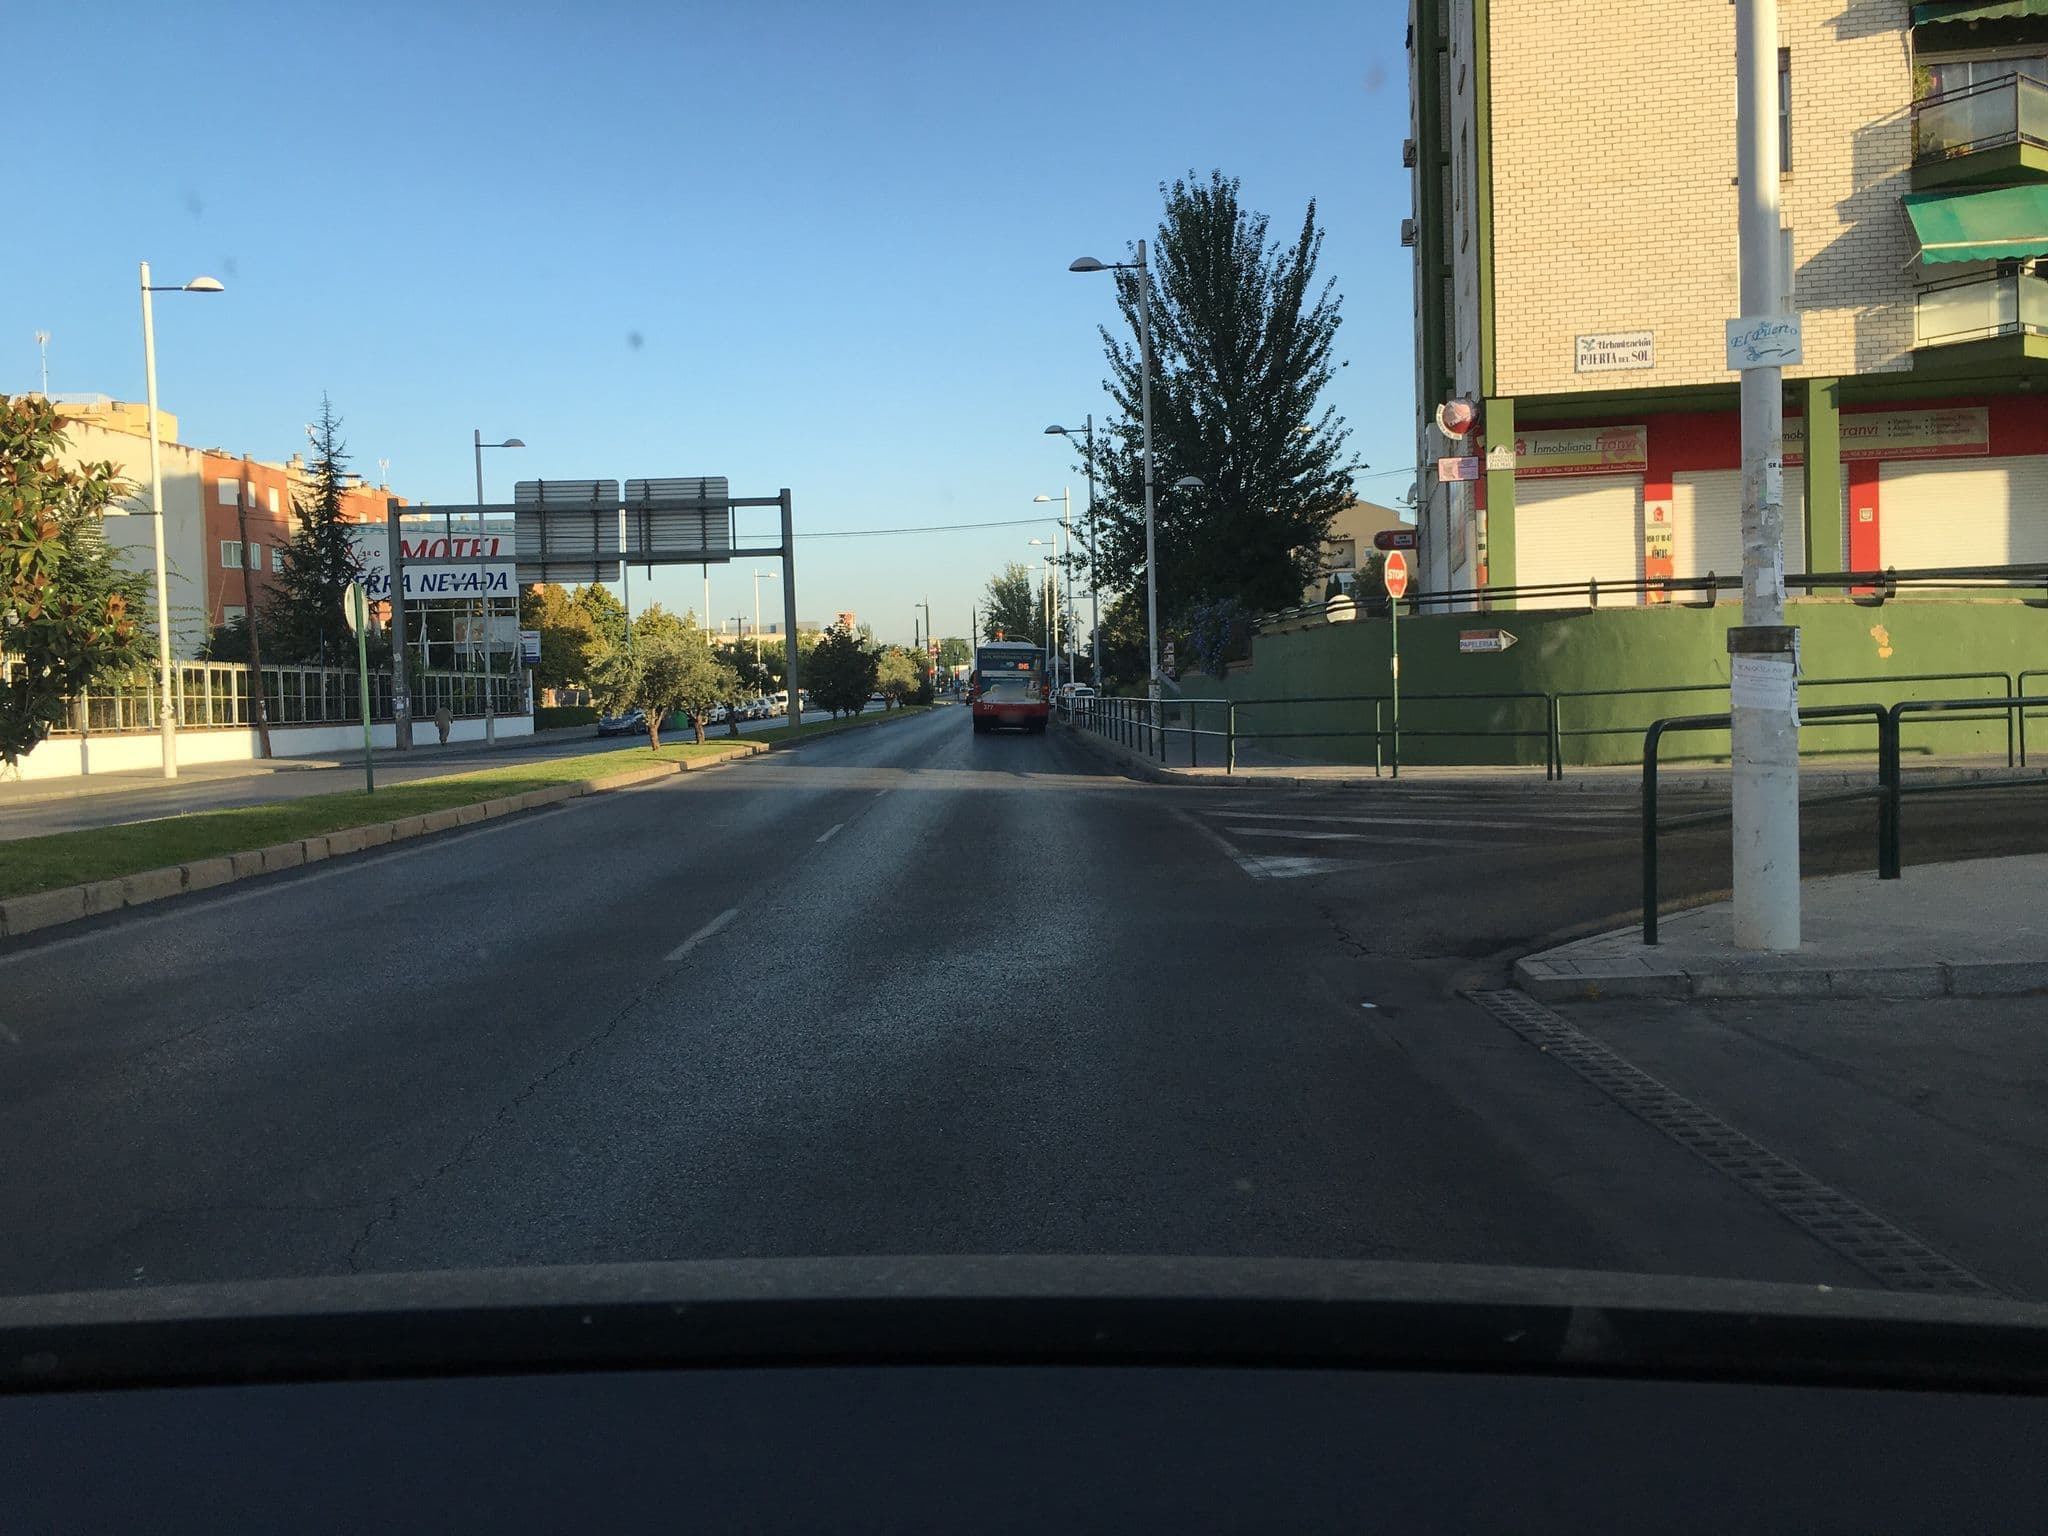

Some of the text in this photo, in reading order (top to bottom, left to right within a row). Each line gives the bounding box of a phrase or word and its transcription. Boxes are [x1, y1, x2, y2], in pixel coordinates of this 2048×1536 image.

[1731, 331, 1751, 347] El
[1580, 352, 1617, 366] PUERTA
[1631, 350, 1649, 362] SOL
[1533, 440, 1591, 454] Inmobiliaria
[421, 572, 508, 592] NEVADA
[1388, 569, 1404, 580] STOP
